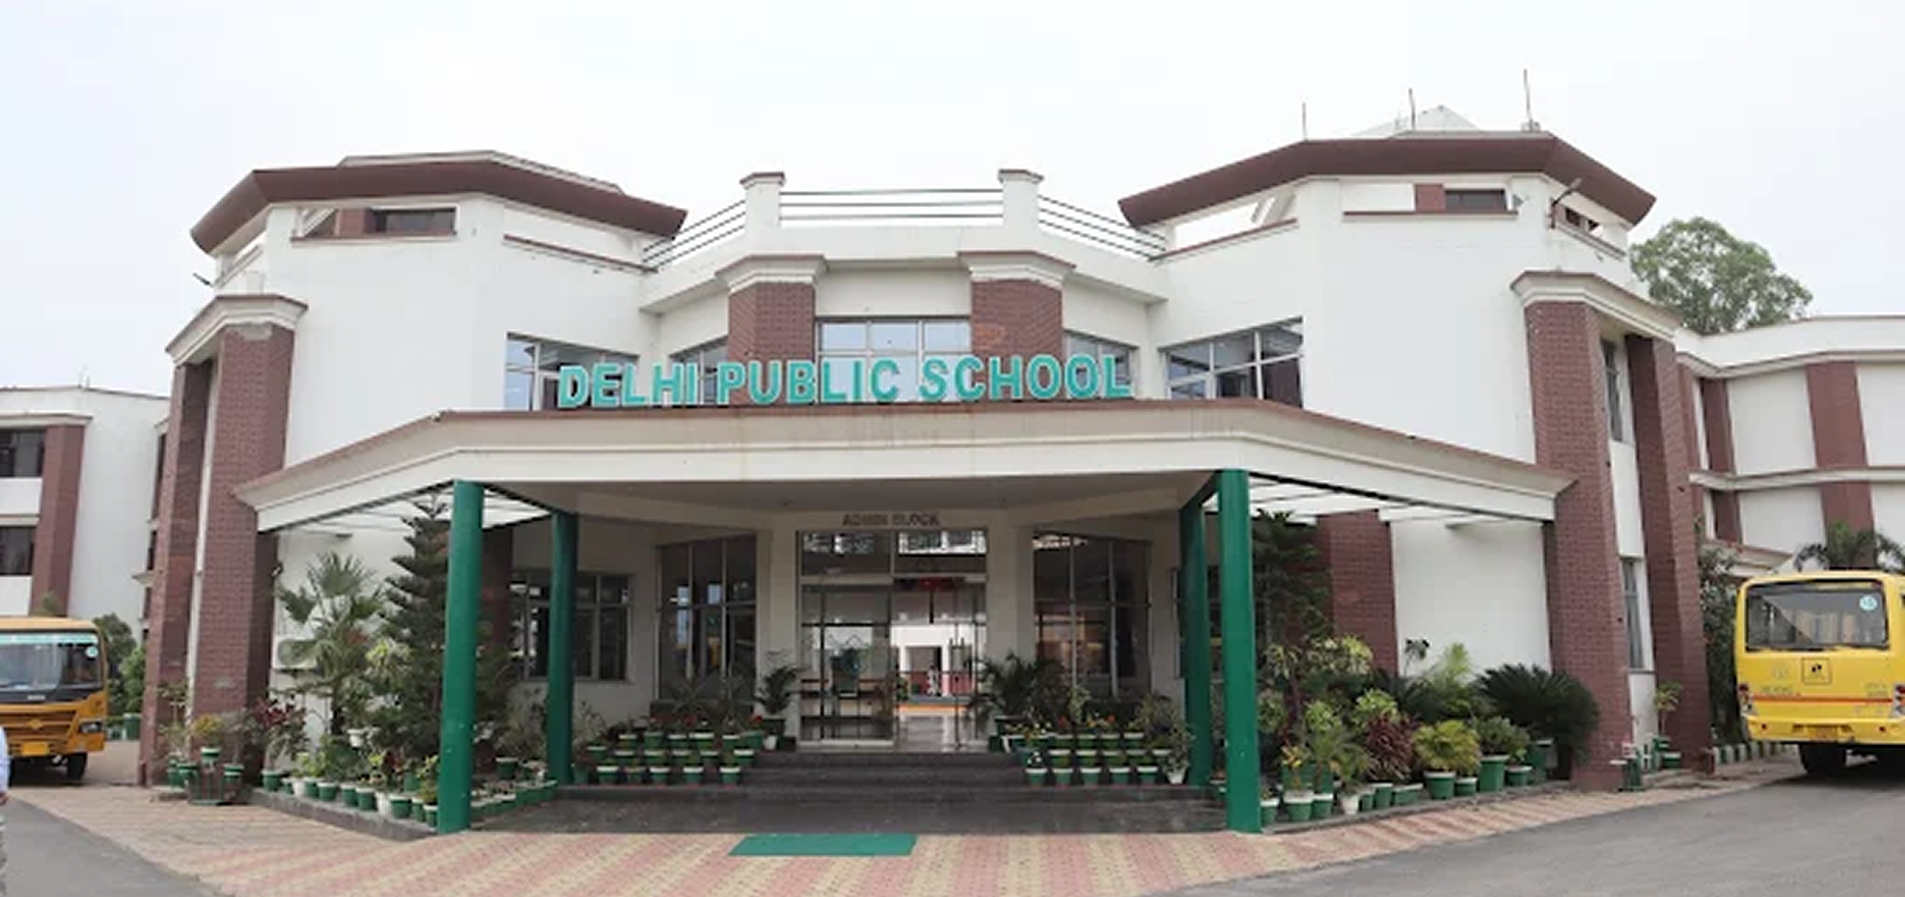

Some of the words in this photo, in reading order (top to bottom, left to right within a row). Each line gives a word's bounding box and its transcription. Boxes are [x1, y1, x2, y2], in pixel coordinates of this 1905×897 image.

[557, 362, 699, 408] DELHI
[716, 358, 899, 405] PUBLIC
[918, 354, 1132, 401] SCHOOL
